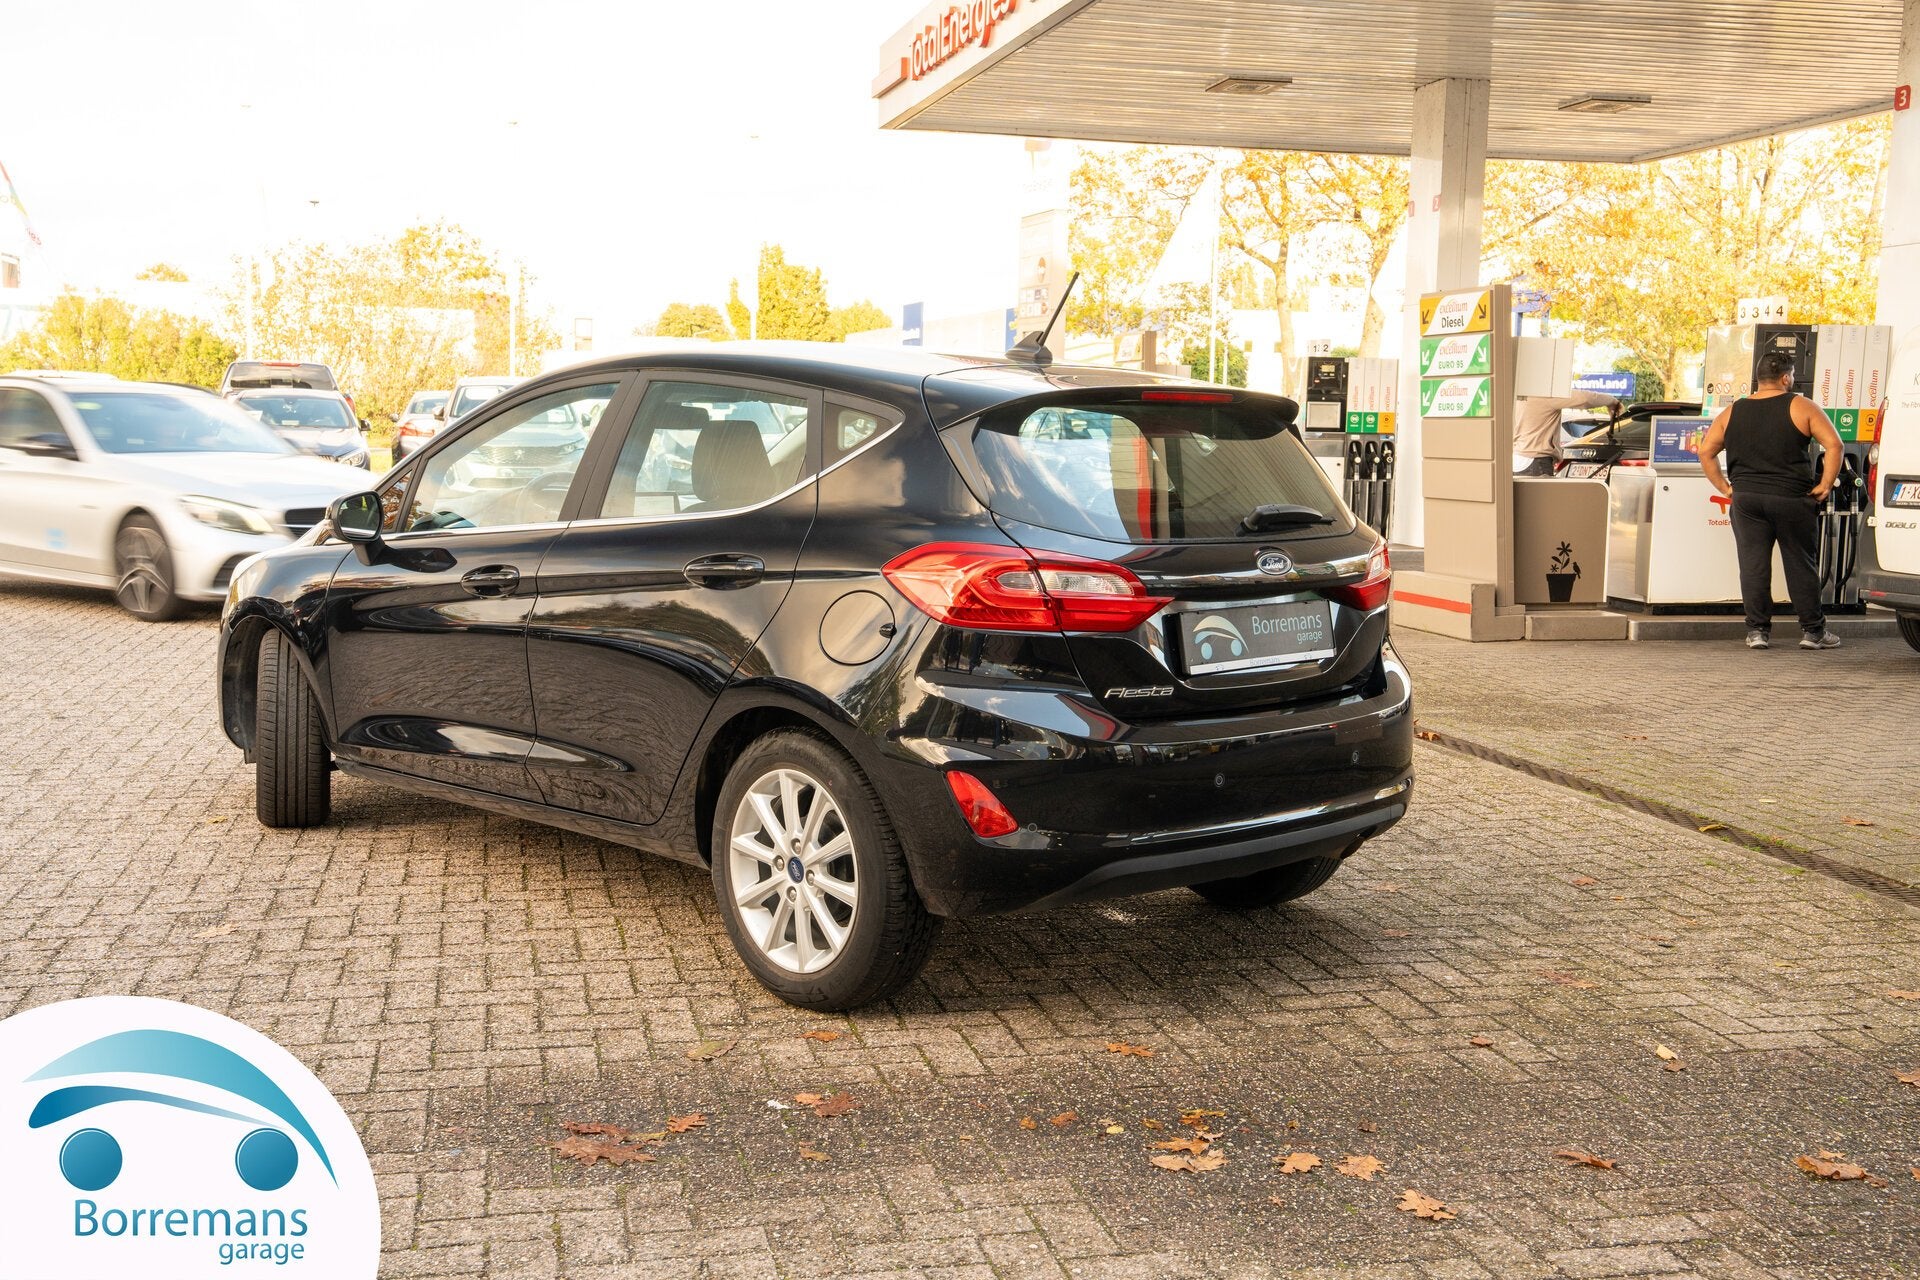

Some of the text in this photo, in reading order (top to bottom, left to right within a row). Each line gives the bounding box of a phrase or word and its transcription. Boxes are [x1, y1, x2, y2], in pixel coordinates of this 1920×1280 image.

[1899, 90, 1907, 107] 3
[1740, 304, 1784, 319] 3 3 4 4
[1441, 315, 1465, 329] Diesel
[1322, 344, 1329, 353] 2
[1438, 361, 1455, 370] EURO
[1822, 369, 1832, 407] excellium
[1846, 369, 1855, 407] excellium
[1870, 369, 1879, 408] excellium
[1438, 402, 1464, 412] EURO 98
[1263, 557, 1285, 570] Ford
[1252, 613, 1323, 636] Borremans
[1296, 630, 1323, 645] garage
